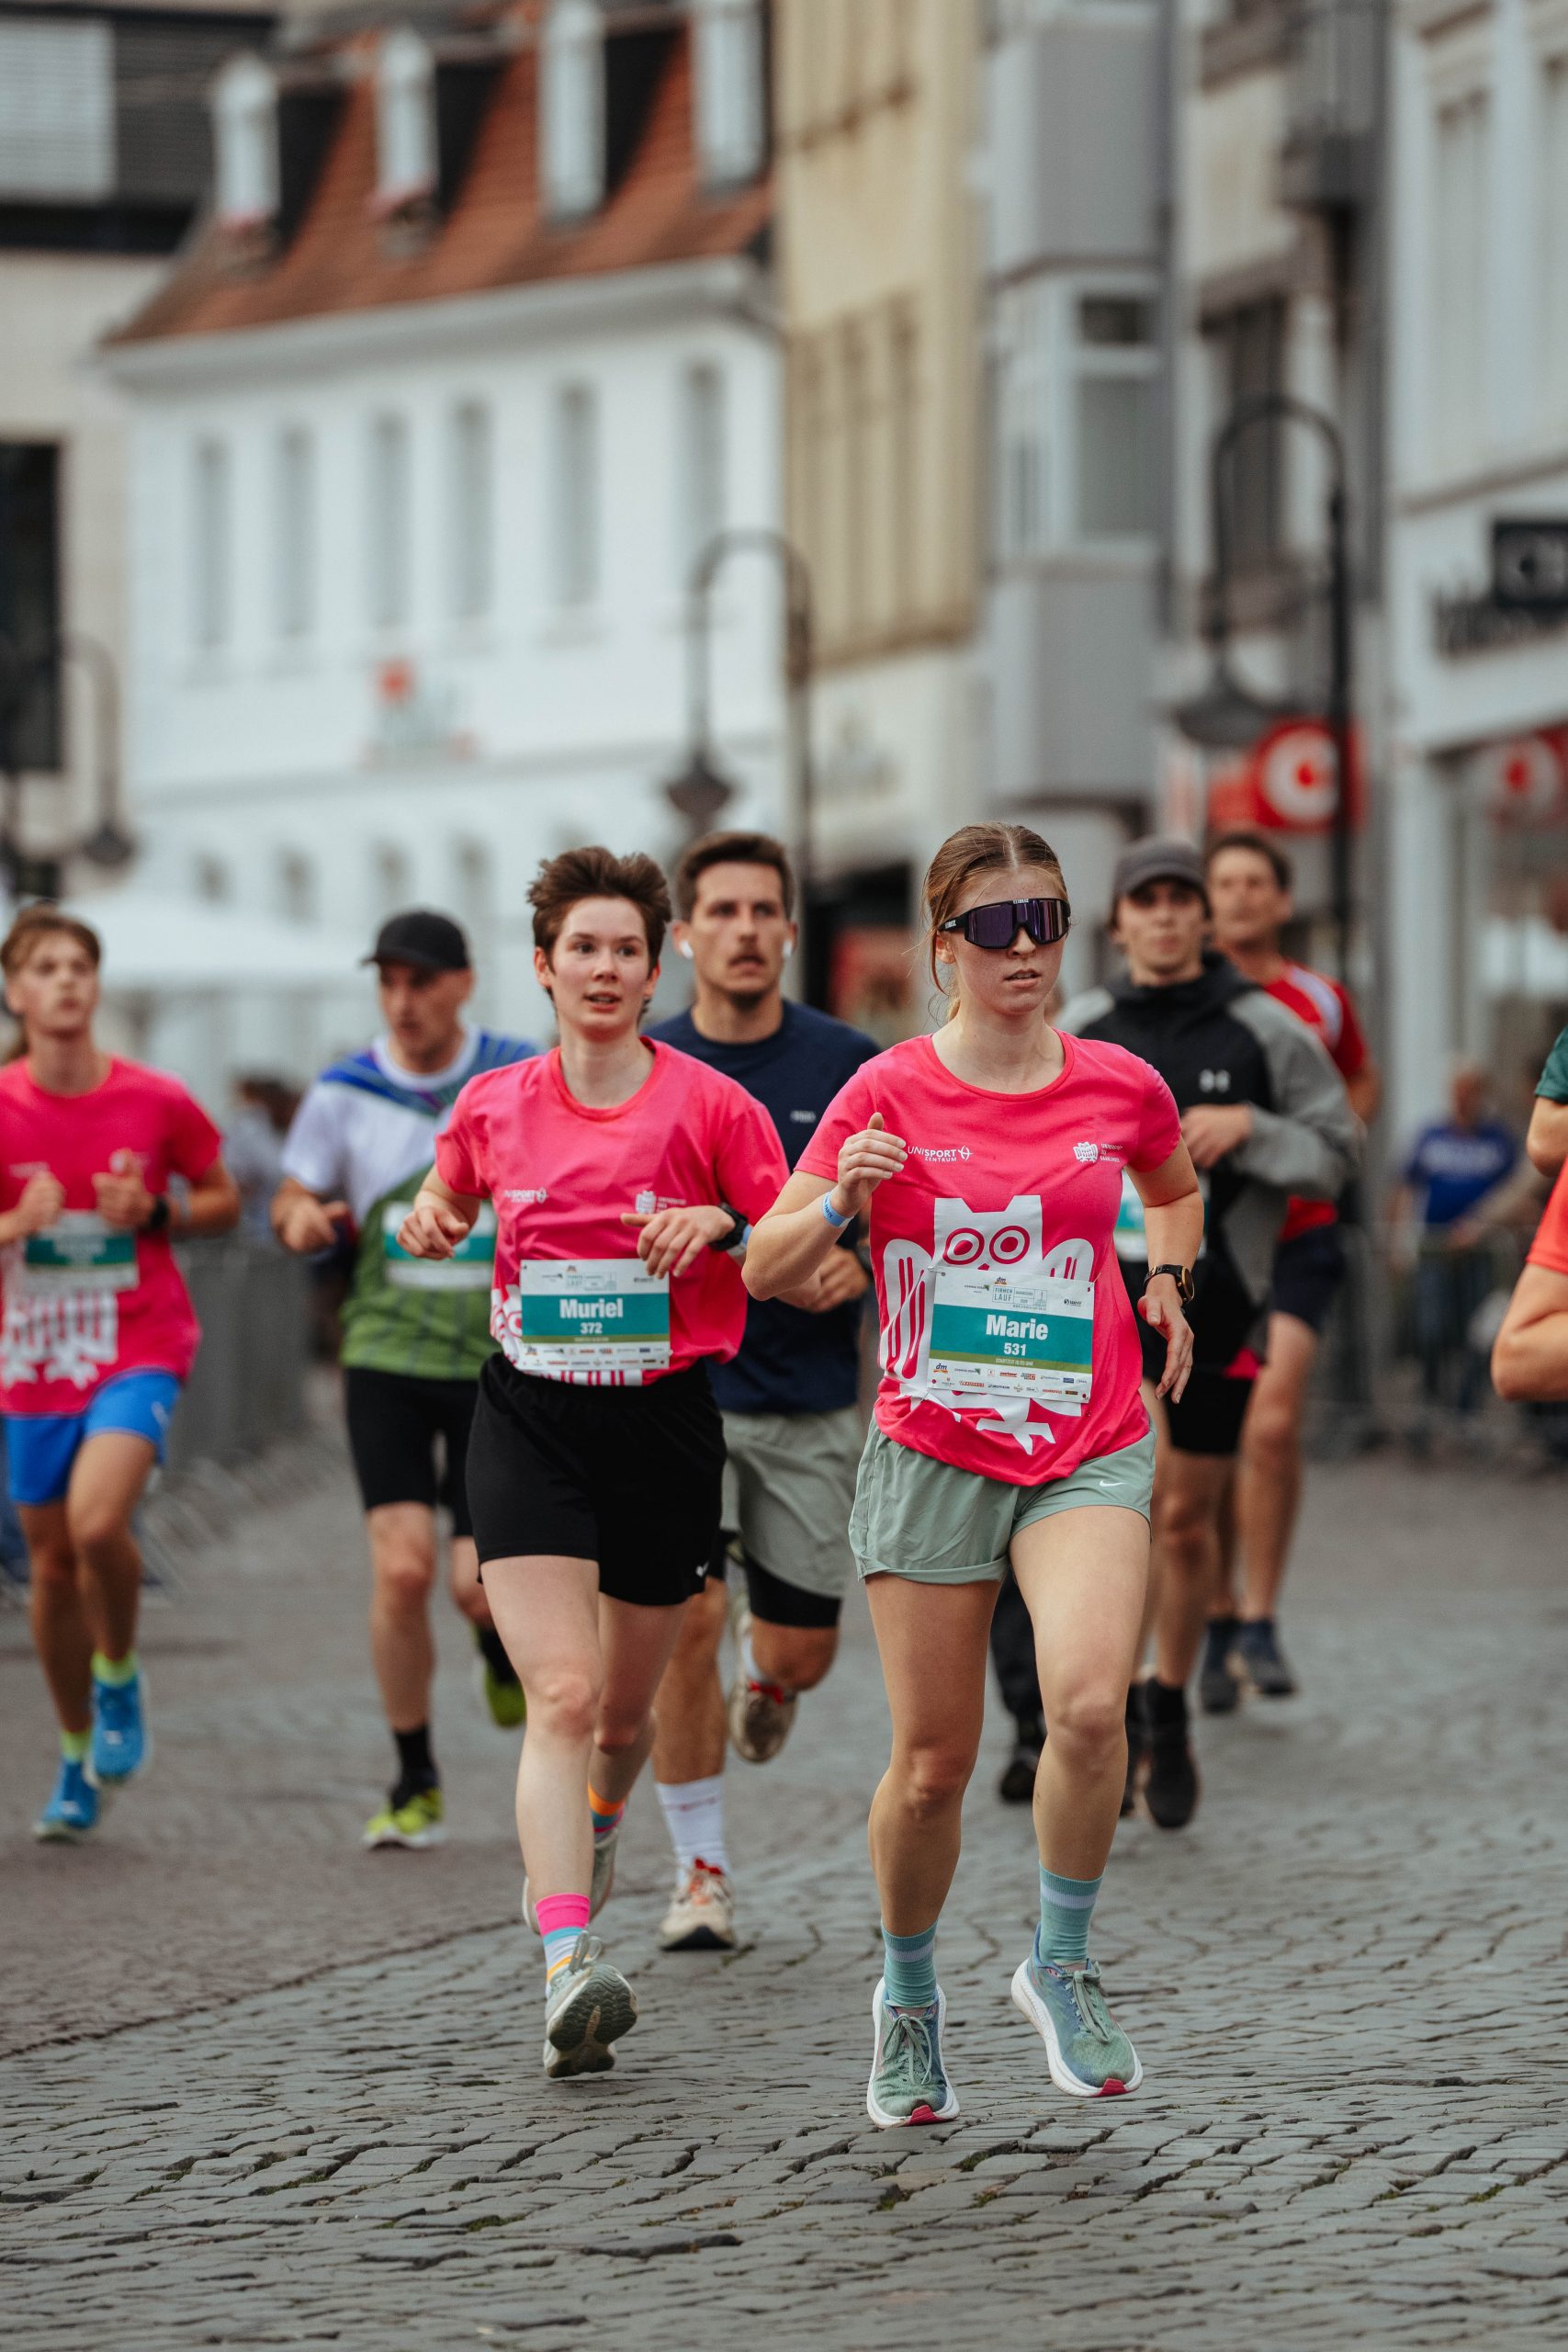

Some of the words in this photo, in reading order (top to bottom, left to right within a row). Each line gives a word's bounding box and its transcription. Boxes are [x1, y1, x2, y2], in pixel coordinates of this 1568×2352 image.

[908, 1146, 957, 1158] UNISPORT
[994, 1293, 1012, 1302] LAUF
[559, 1297, 624, 1318] Muriel
[580, 1322, 603, 1334] 372
[986, 1314, 1049, 1340] Marie
[1003, 1342, 1027, 1356] 531
[935, 1363, 947, 1371] dm
